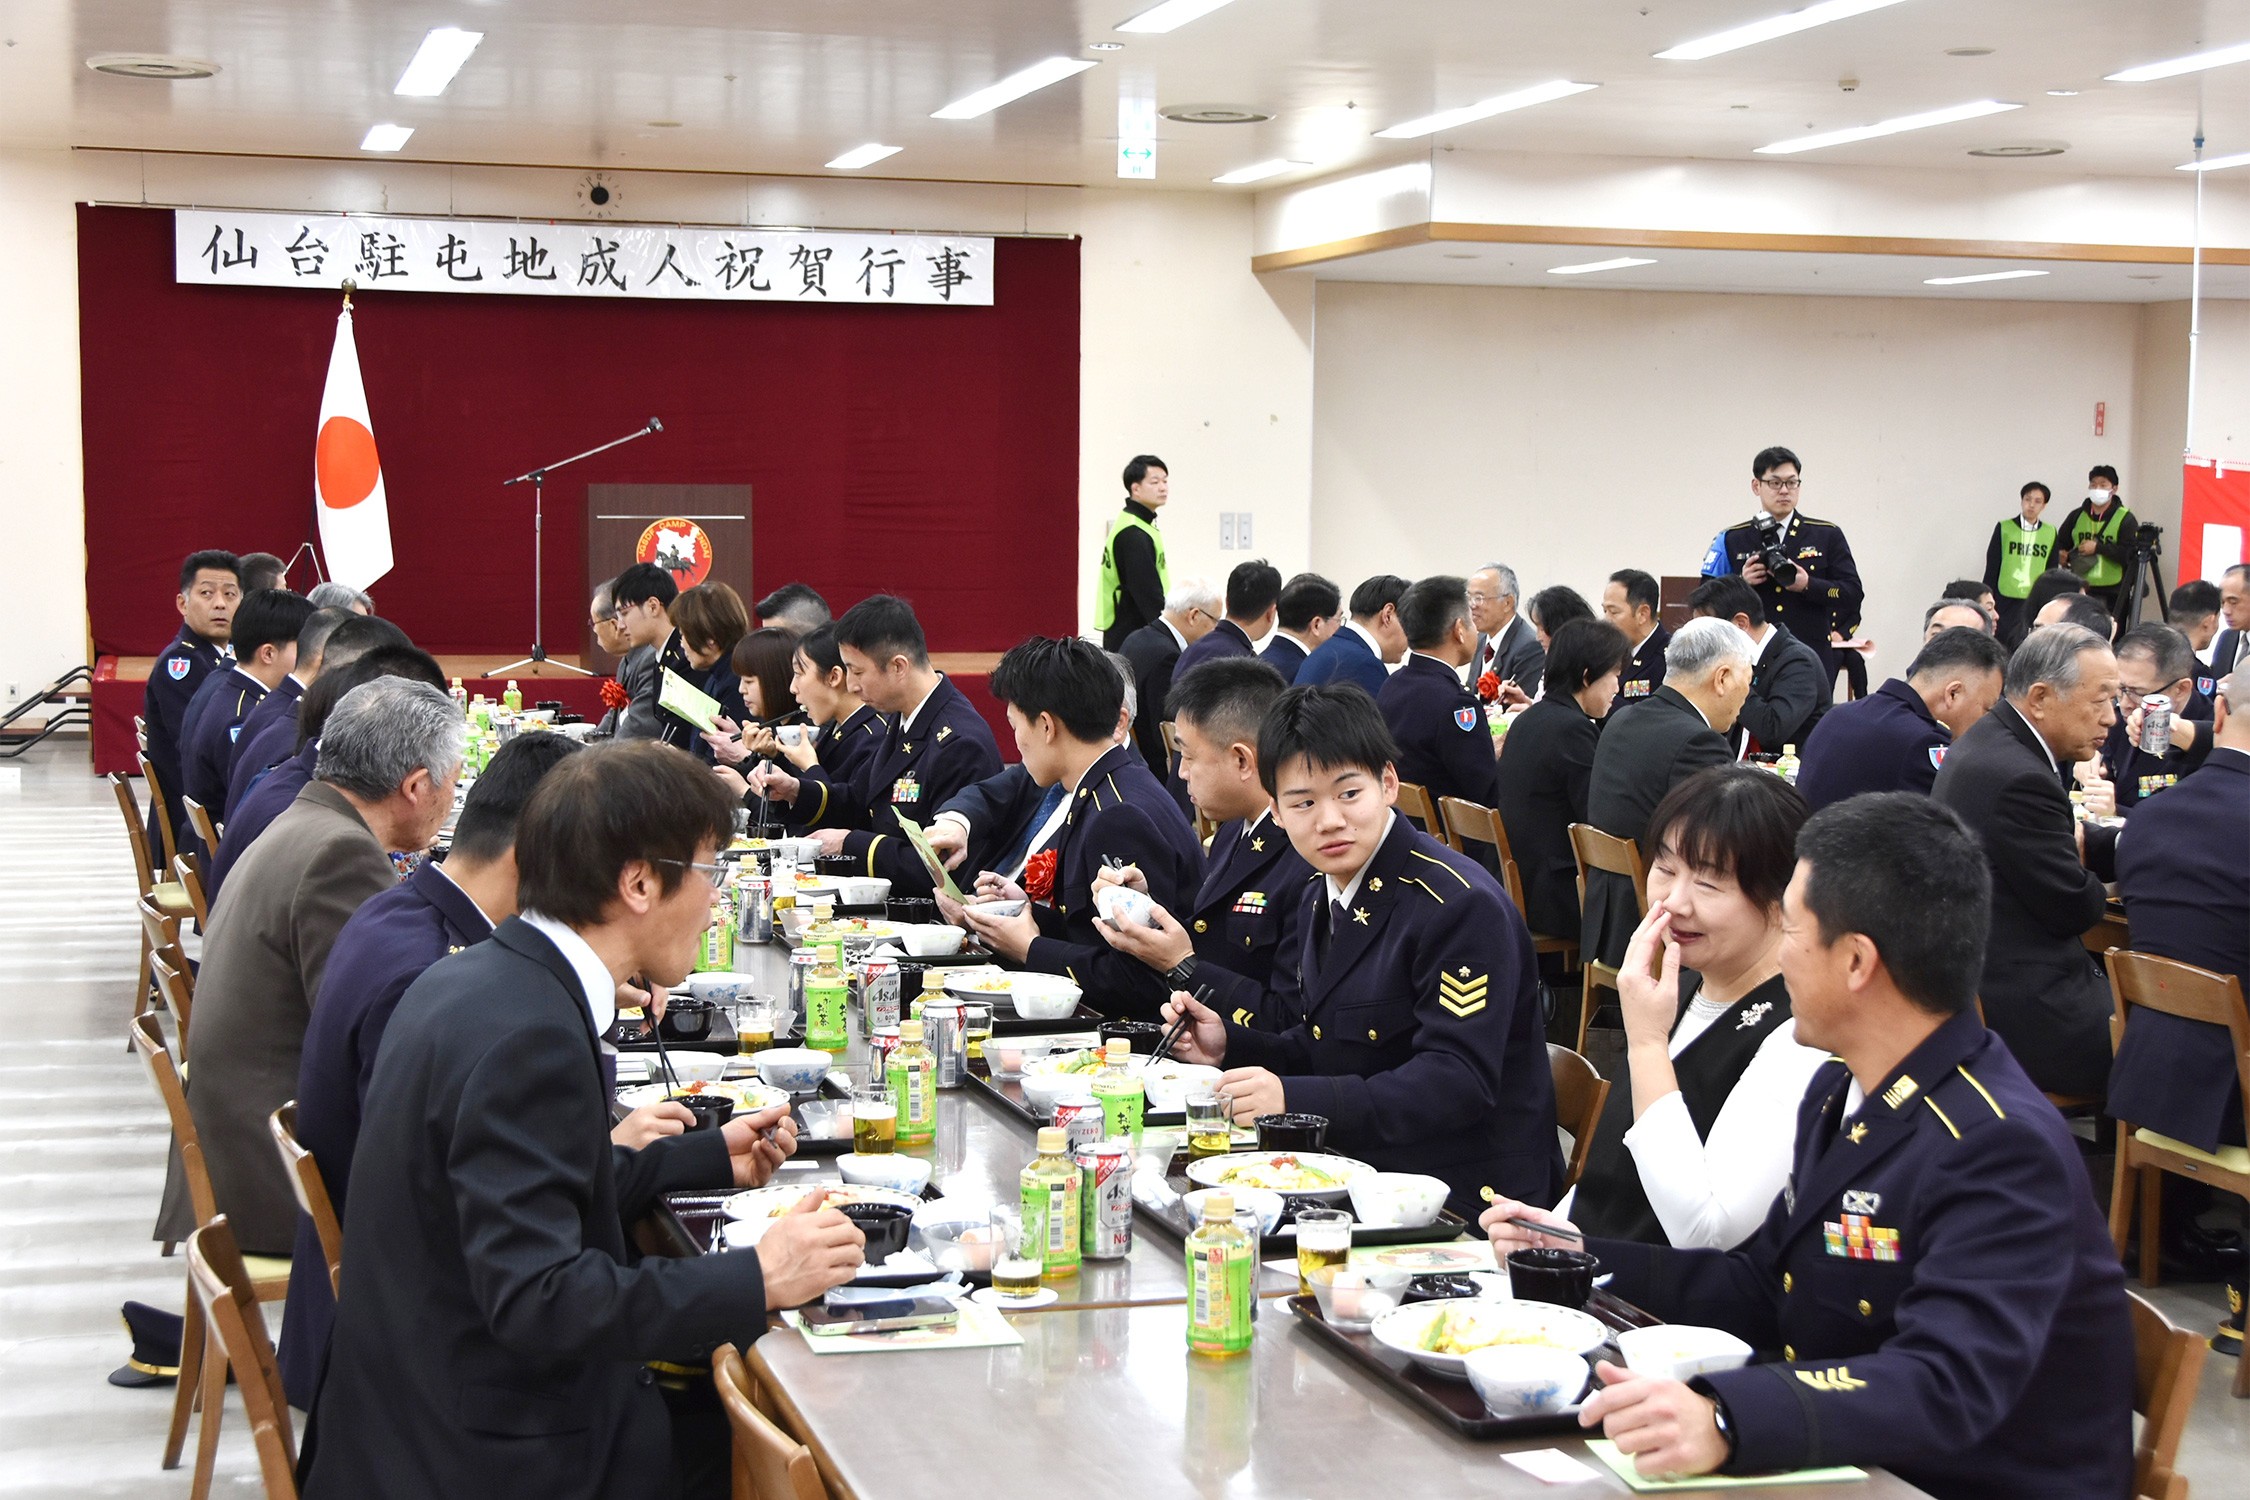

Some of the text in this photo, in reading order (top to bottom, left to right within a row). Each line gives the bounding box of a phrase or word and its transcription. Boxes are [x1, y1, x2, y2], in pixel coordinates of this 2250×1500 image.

[201, 223, 974, 301] 仙台駐屯地成人祝賀行事
[658, 521, 687, 530] CAMP
[2008, 541, 2049, 559] PRESS
